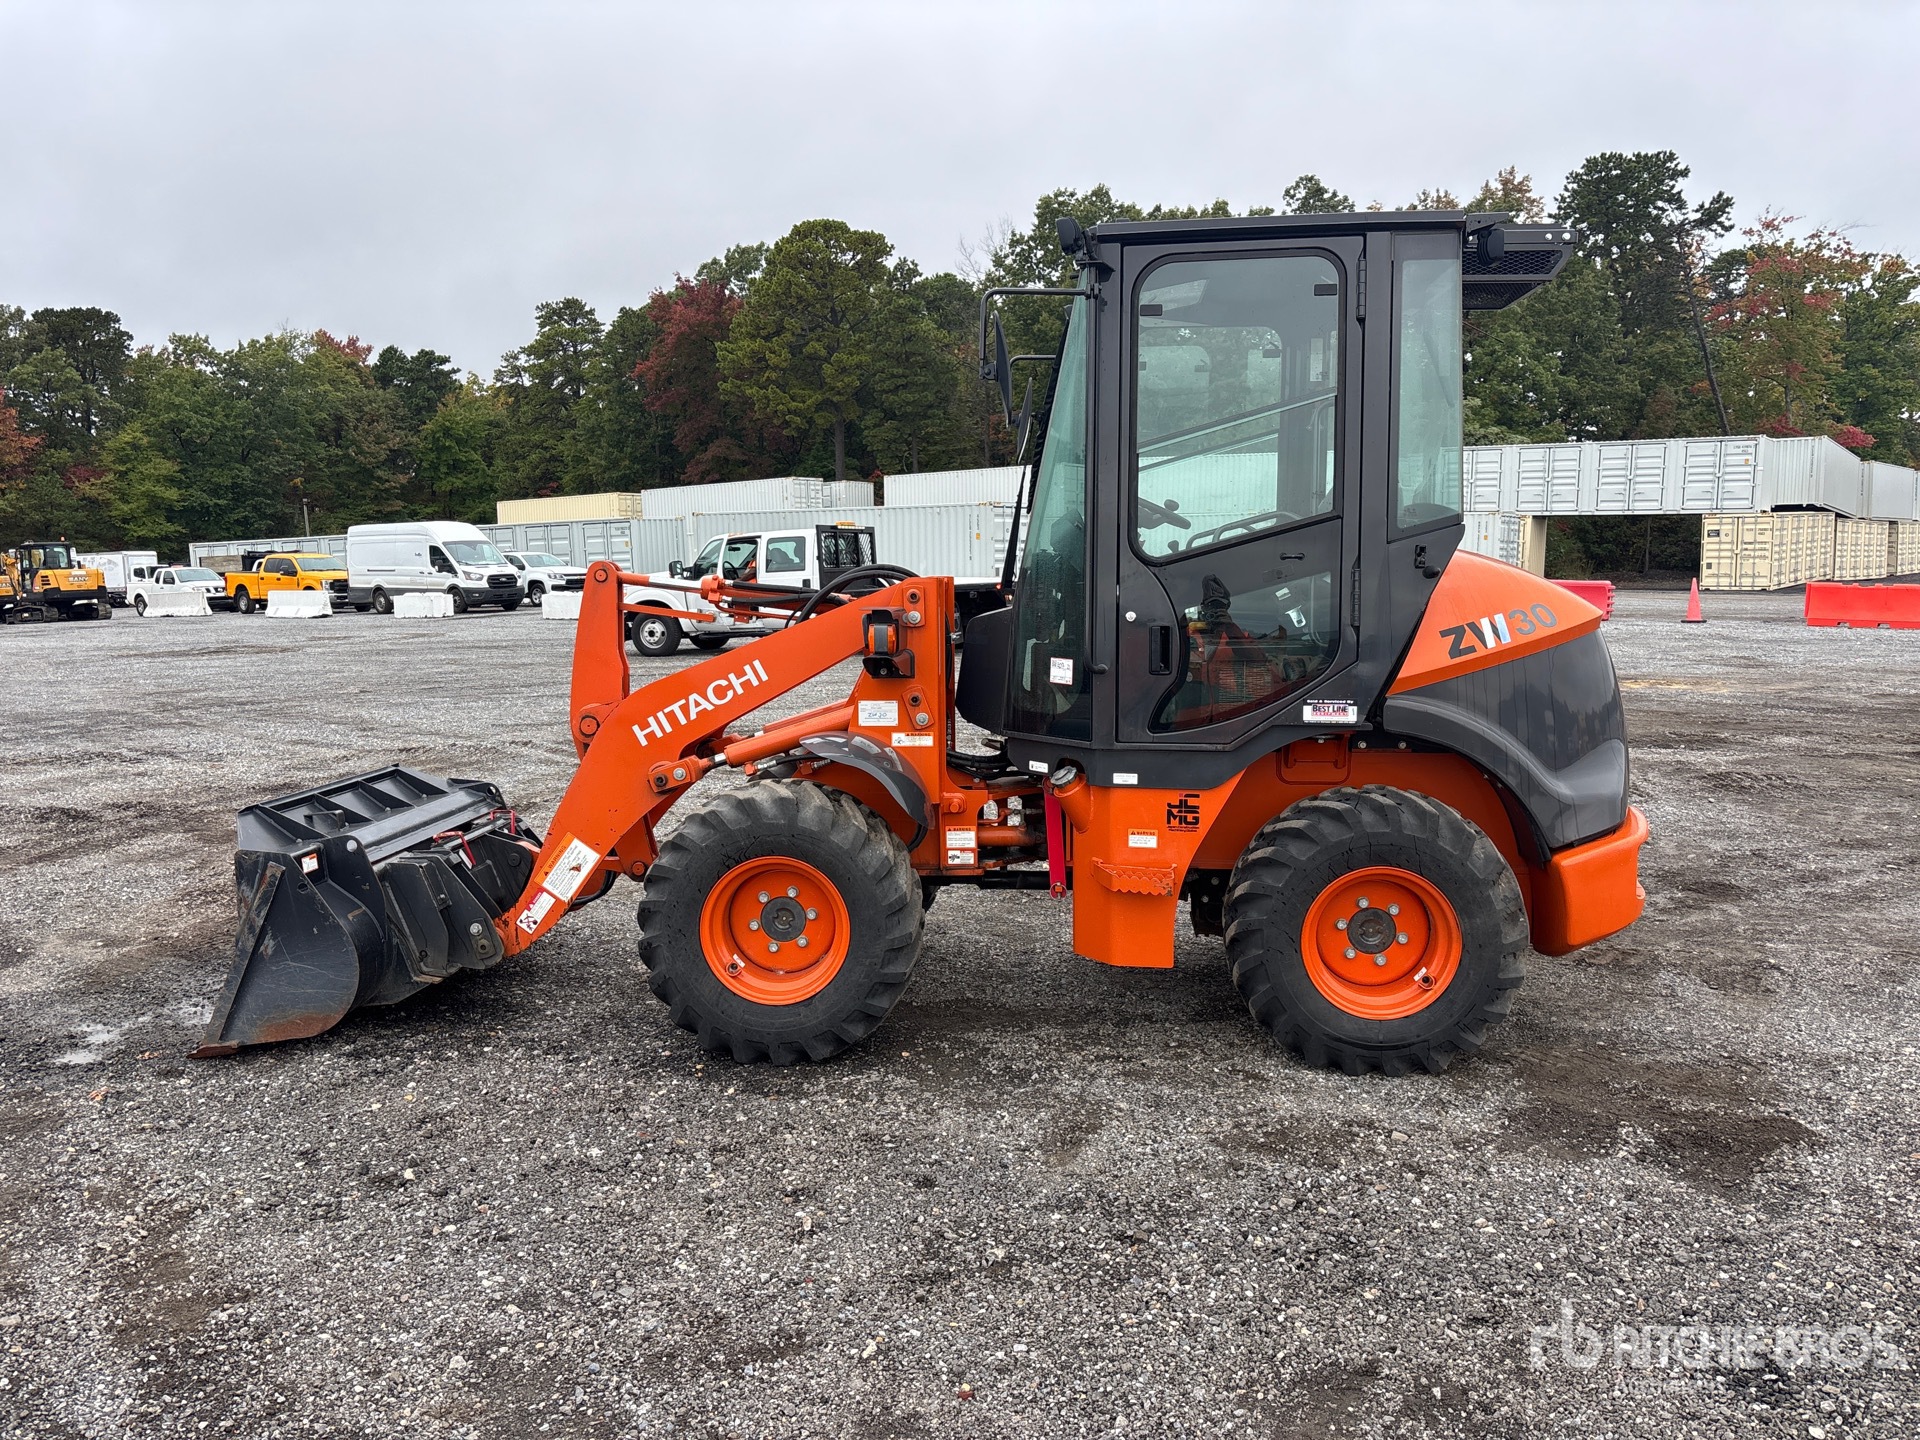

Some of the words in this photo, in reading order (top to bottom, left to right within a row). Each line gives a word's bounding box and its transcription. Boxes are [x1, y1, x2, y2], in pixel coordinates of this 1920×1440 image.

[1439, 603, 1557, 660] ZW30
[631, 659, 769, 747] HITACHI
[1312, 704, 1331, 713] BEST
[1332, 704, 1348, 713] LINE
[548, 845, 567, 869] WARNING
